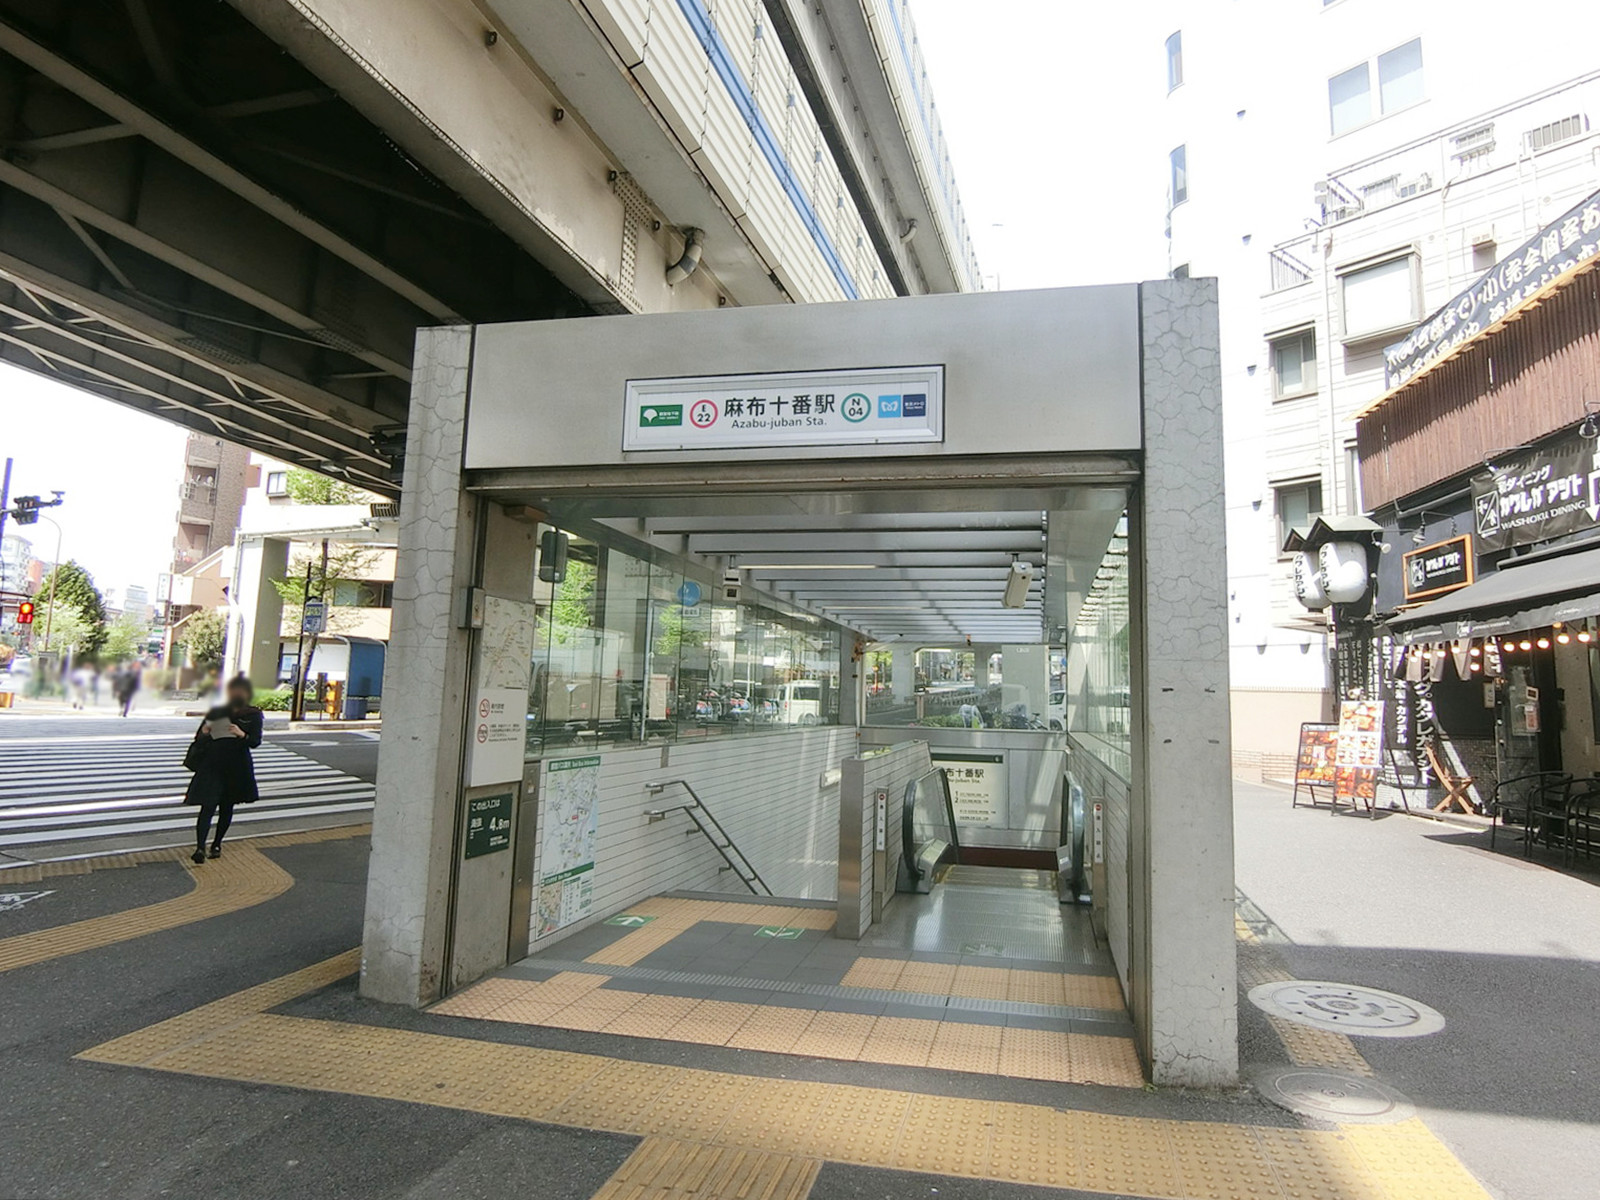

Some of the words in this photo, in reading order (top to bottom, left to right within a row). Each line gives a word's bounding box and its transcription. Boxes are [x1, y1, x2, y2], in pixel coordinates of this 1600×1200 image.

[701, 404, 708, 413] E
[724, 393, 835, 418] 麻布十番駅
[852, 398, 860, 407] N
[697, 413, 711, 423] 22
[848, 407, 864, 417] 04
[731, 419, 802, 431] Azabu-juban
[806, 417, 827, 428] Sta.
[1551, 500, 1587, 519] DINING
[489, 816, 511, 832] 4.8m
